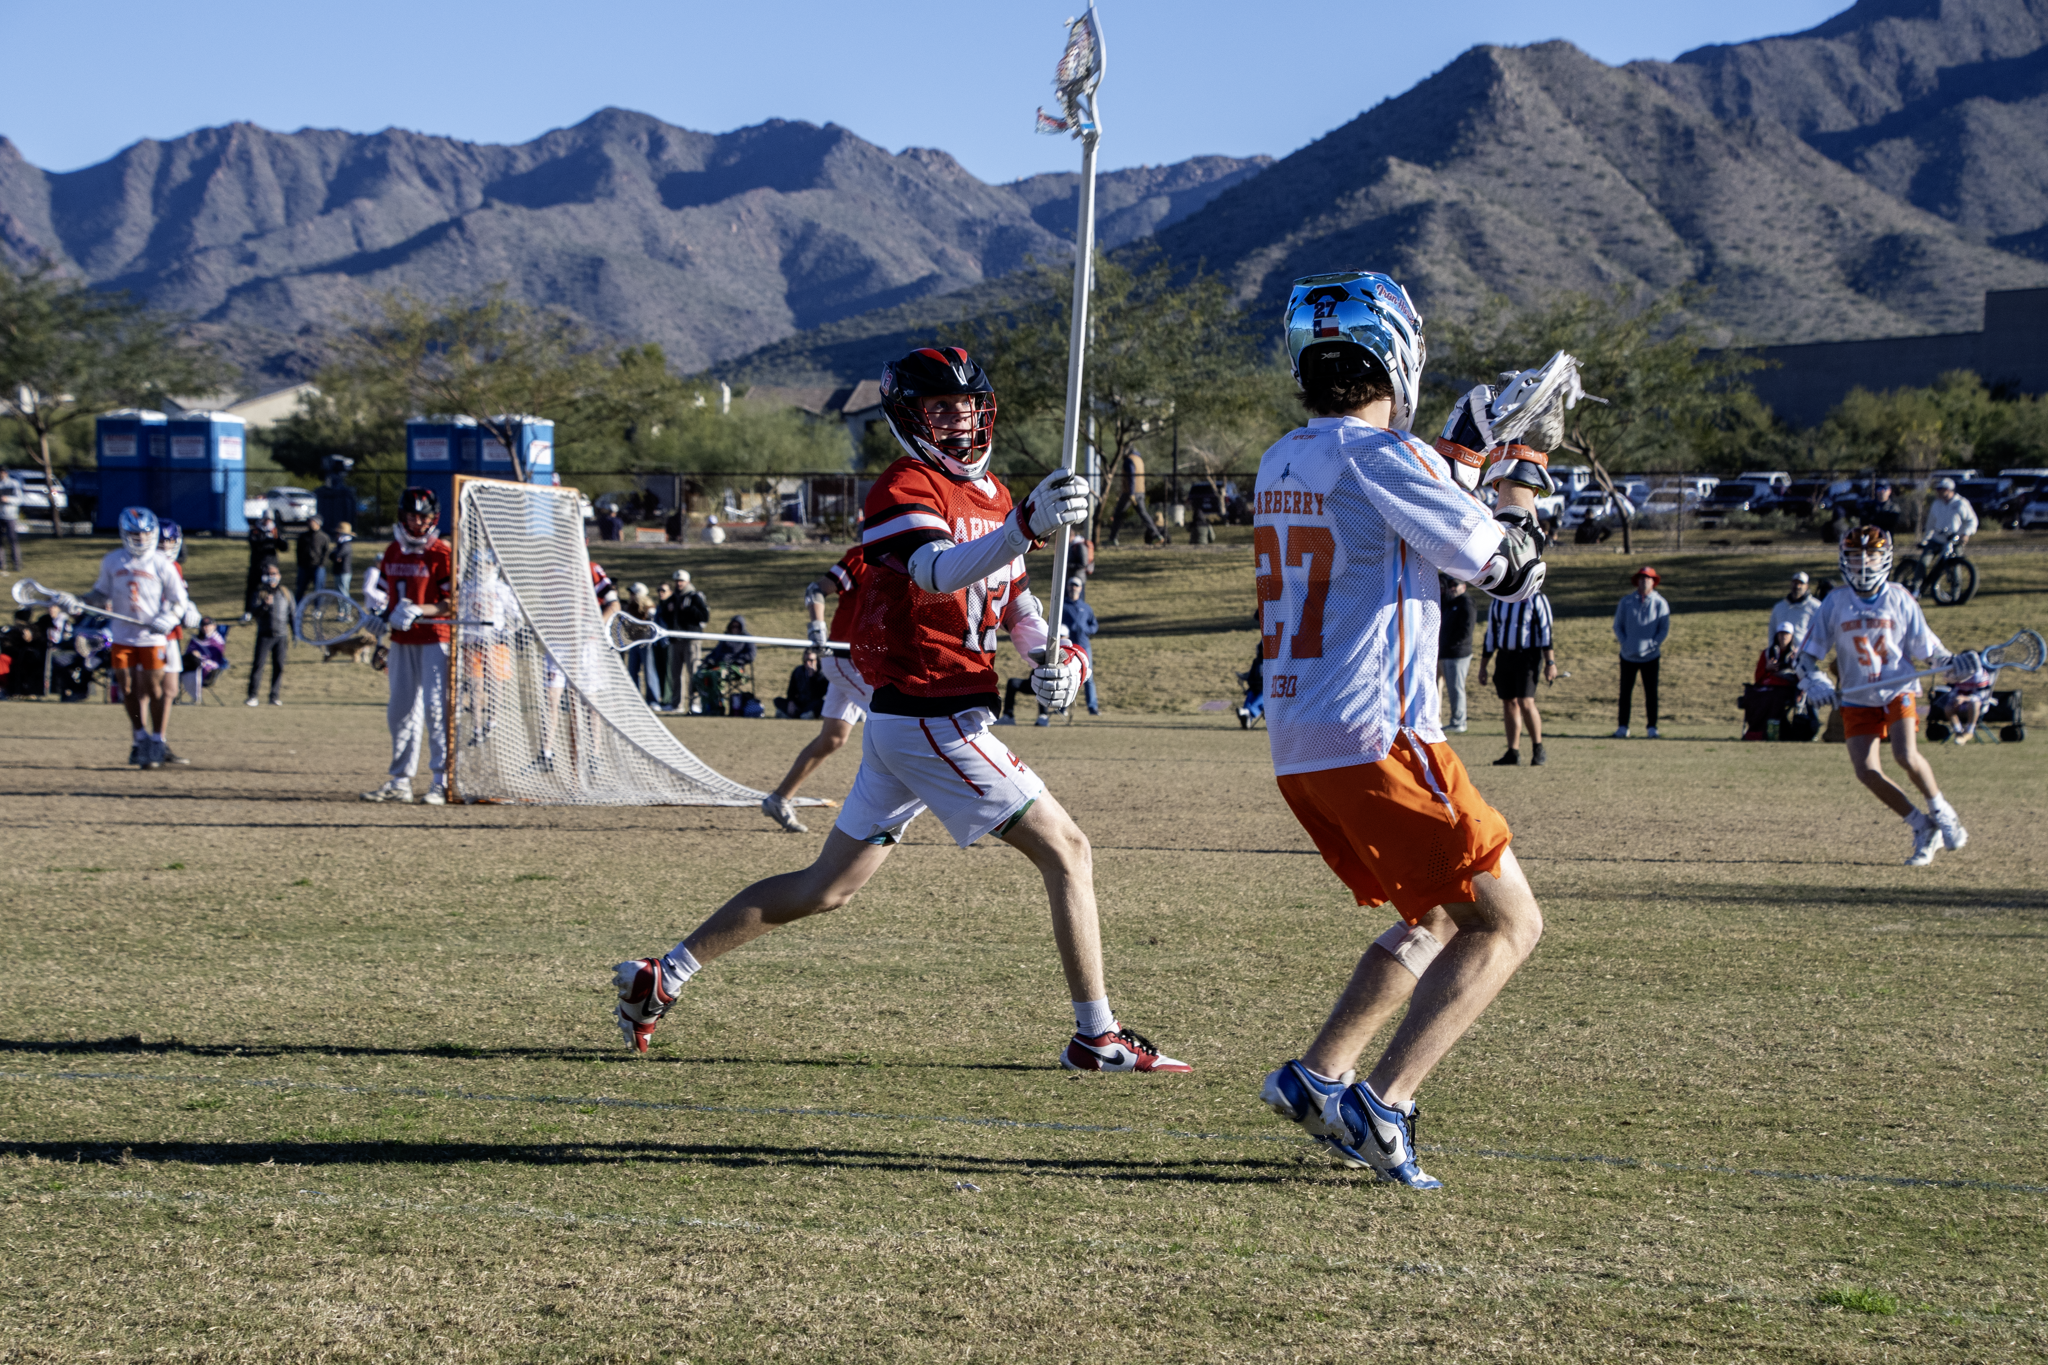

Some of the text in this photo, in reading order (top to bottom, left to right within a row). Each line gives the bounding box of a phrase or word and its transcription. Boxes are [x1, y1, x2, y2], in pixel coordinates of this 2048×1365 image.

[1313, 301, 1338, 318] 27
[1254, 525, 1336, 660] 27
[1852, 635, 1889, 666] 54
